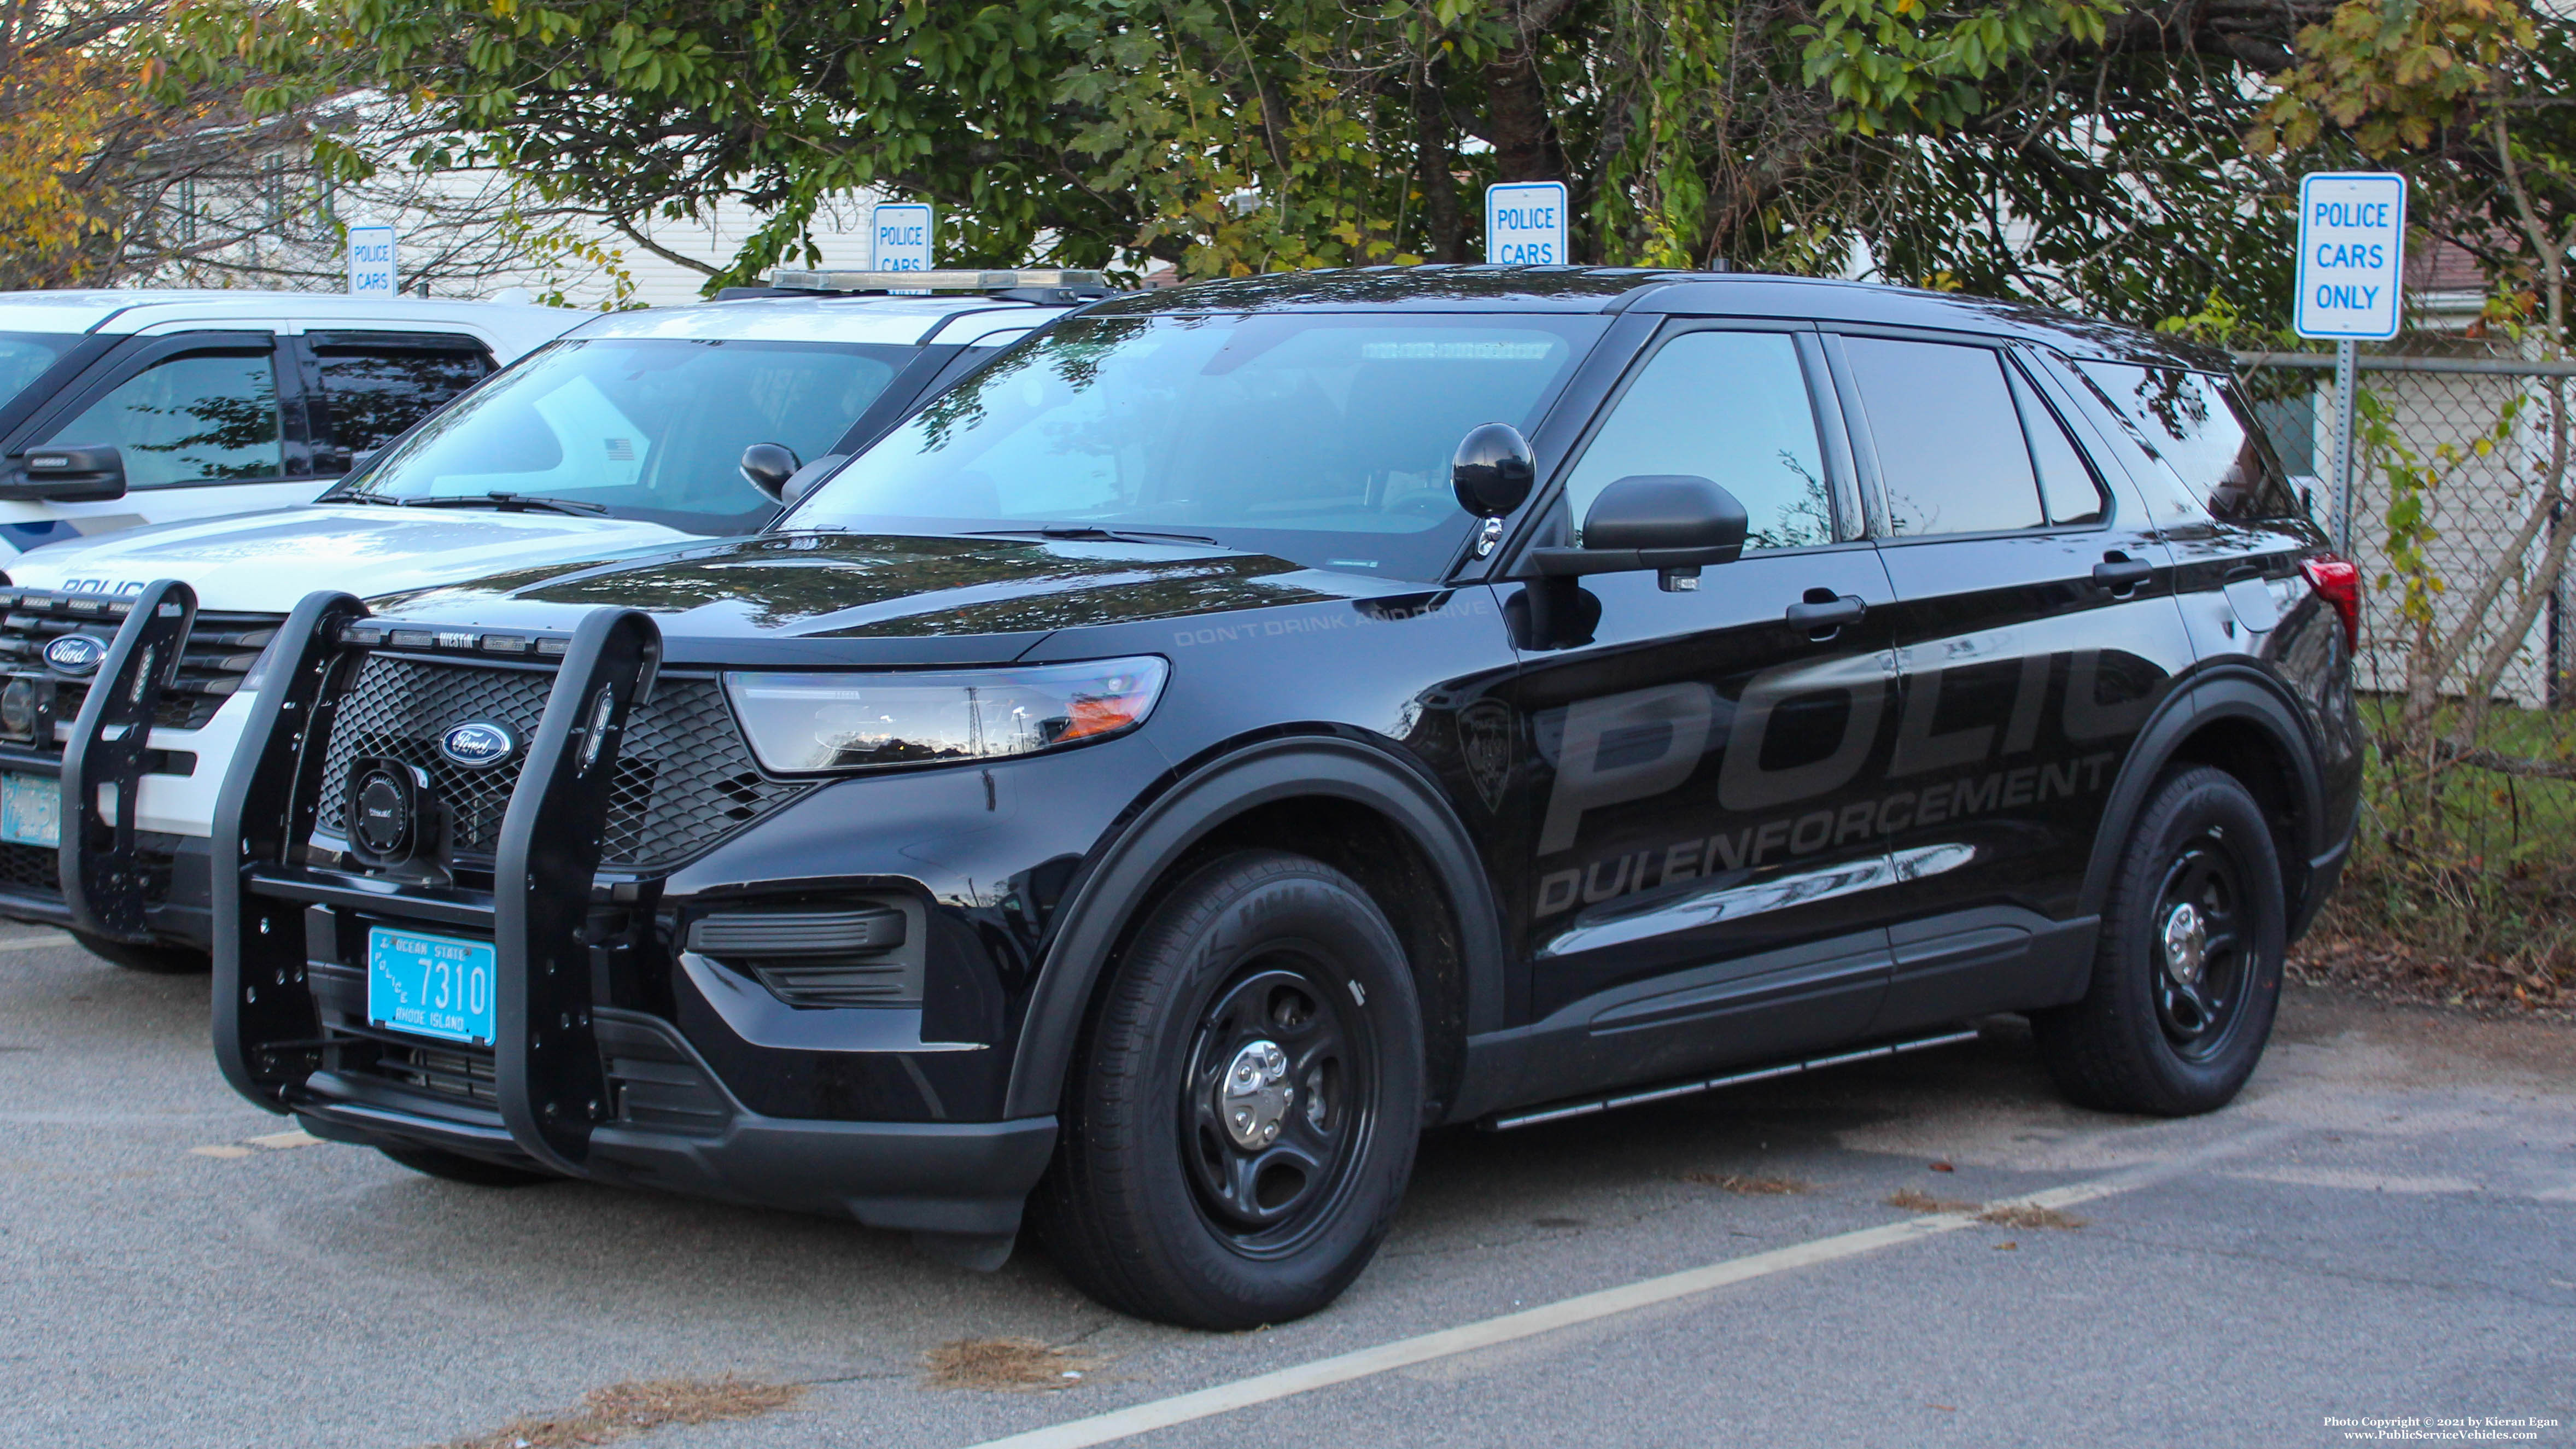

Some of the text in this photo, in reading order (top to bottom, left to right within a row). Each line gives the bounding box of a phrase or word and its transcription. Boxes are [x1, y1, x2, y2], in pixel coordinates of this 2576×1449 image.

[1498, 208, 1555, 230] POLICE
[2315, 203, 2388, 227] POLICE
[880, 226, 922, 245] POLICE
[354, 245, 389, 262] POLICE
[1501, 243, 1552, 264] CARS
[2317, 243, 2383, 268] CARS
[357, 273, 388, 290] CARS
[2317, 284, 2379, 309] ONLY
[1174, 602, 1488, 647] DON'T DRINK AND DRIVE
[51, 639, 90, 663] Ford
[452, 730, 492, 755] Ford
[1660, 752, 2115, 887] ENFORCEMENT
[396, 938, 466, 961] OCEAN STATE
[375, 952, 407, 1003] POLICE
[418, 957, 486, 1015] 7310
[395, 1007, 464, 1032] RHODE ISLAND
